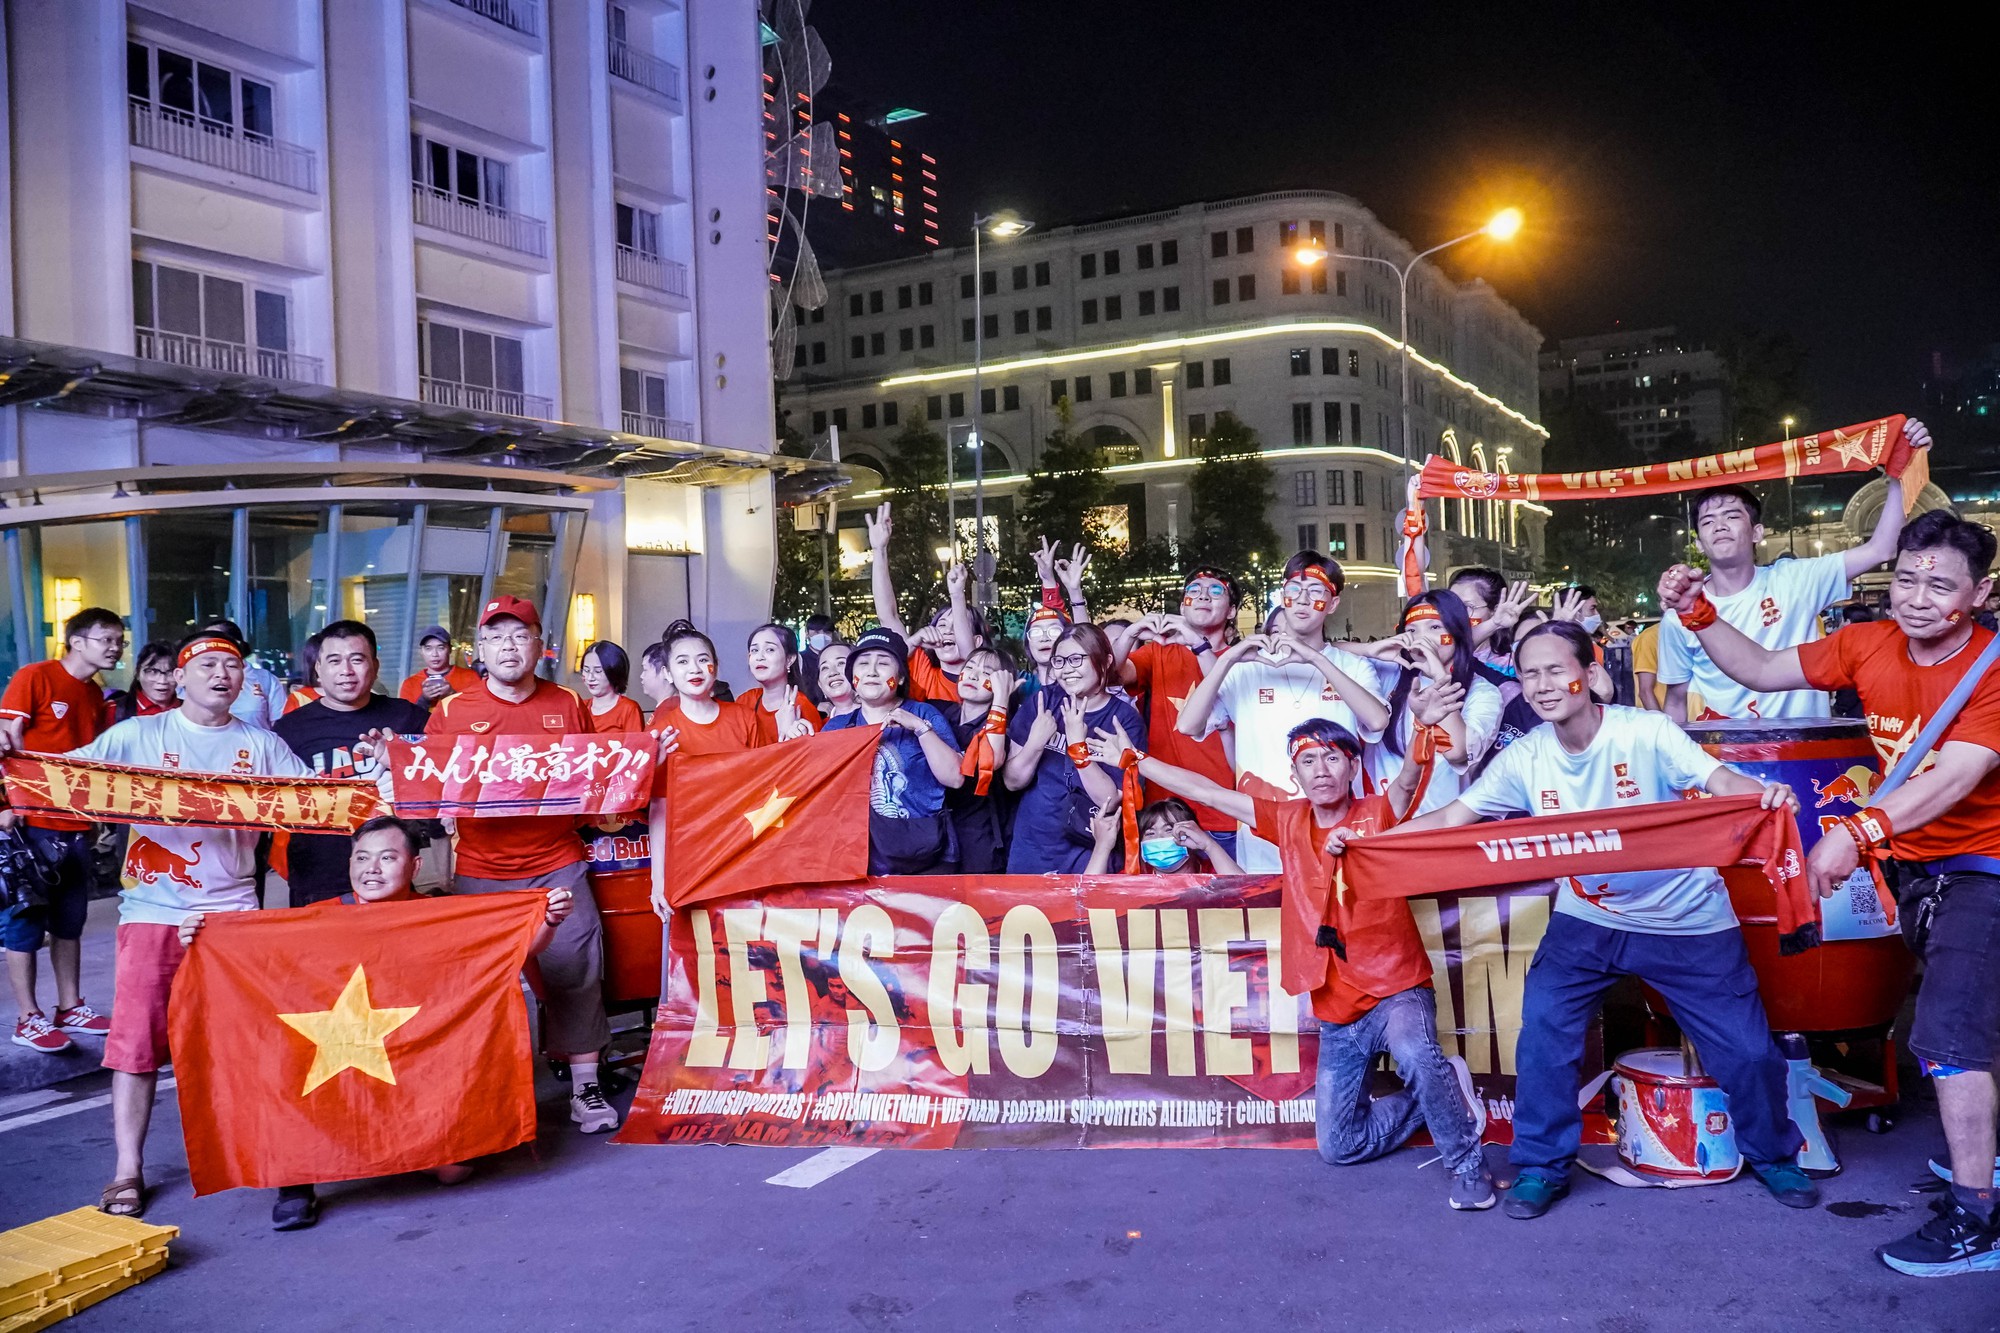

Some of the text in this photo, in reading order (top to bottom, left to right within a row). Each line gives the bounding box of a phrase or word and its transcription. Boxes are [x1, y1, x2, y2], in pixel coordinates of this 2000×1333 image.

[1561, 447, 1759, 494] VIỆT NAM
[217, 784, 356, 832] NAM
[584, 836, 613, 862] ed
[1477, 829, 1623, 862] VIETNAM
[685, 904, 900, 1072] LET'S
[927, 903, 1059, 1079] GO
[661, 1089, 804, 1120] #VIETNAMSUPPORTERS
[812, 1092, 931, 1125] #GOTEAMVIETNAM
[940, 1096, 999, 1124] VIETNAM
[1001, 1099, 1067, 1125] FOOTBALL
[1070, 1099, 1157, 1127] SUPPORTERS
[1159, 1100, 1223, 1127] ALLIANCE
[1236, 1095, 1276, 1125] CÙNG
[1279, 1099, 1317, 1124] NHAU
[732, 1120, 791, 1144] NAM
